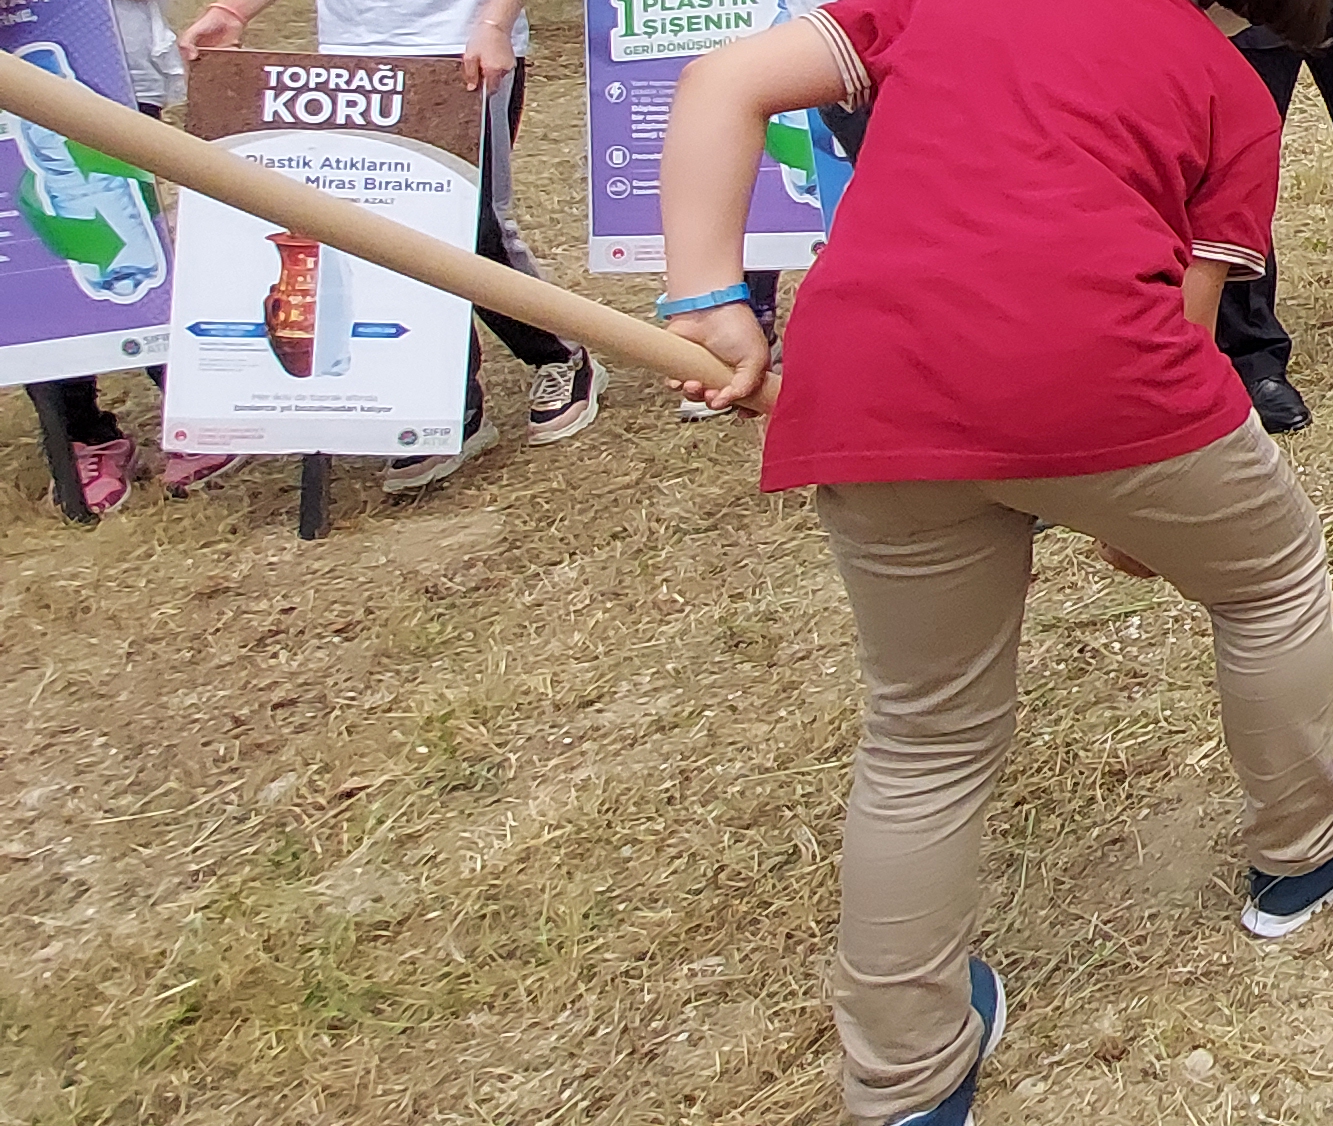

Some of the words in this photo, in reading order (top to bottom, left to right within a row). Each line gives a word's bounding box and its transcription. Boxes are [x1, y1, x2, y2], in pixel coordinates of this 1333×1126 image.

[624, 42, 654, 55] GERİ
[263, 64, 405, 92] TOPRAĞI
[262, 90, 403, 126] KORU
[319, 156, 411, 173] Atıklarını
[305, 175, 356, 190] Miras
[364, 176, 452, 192] Bırakma!
